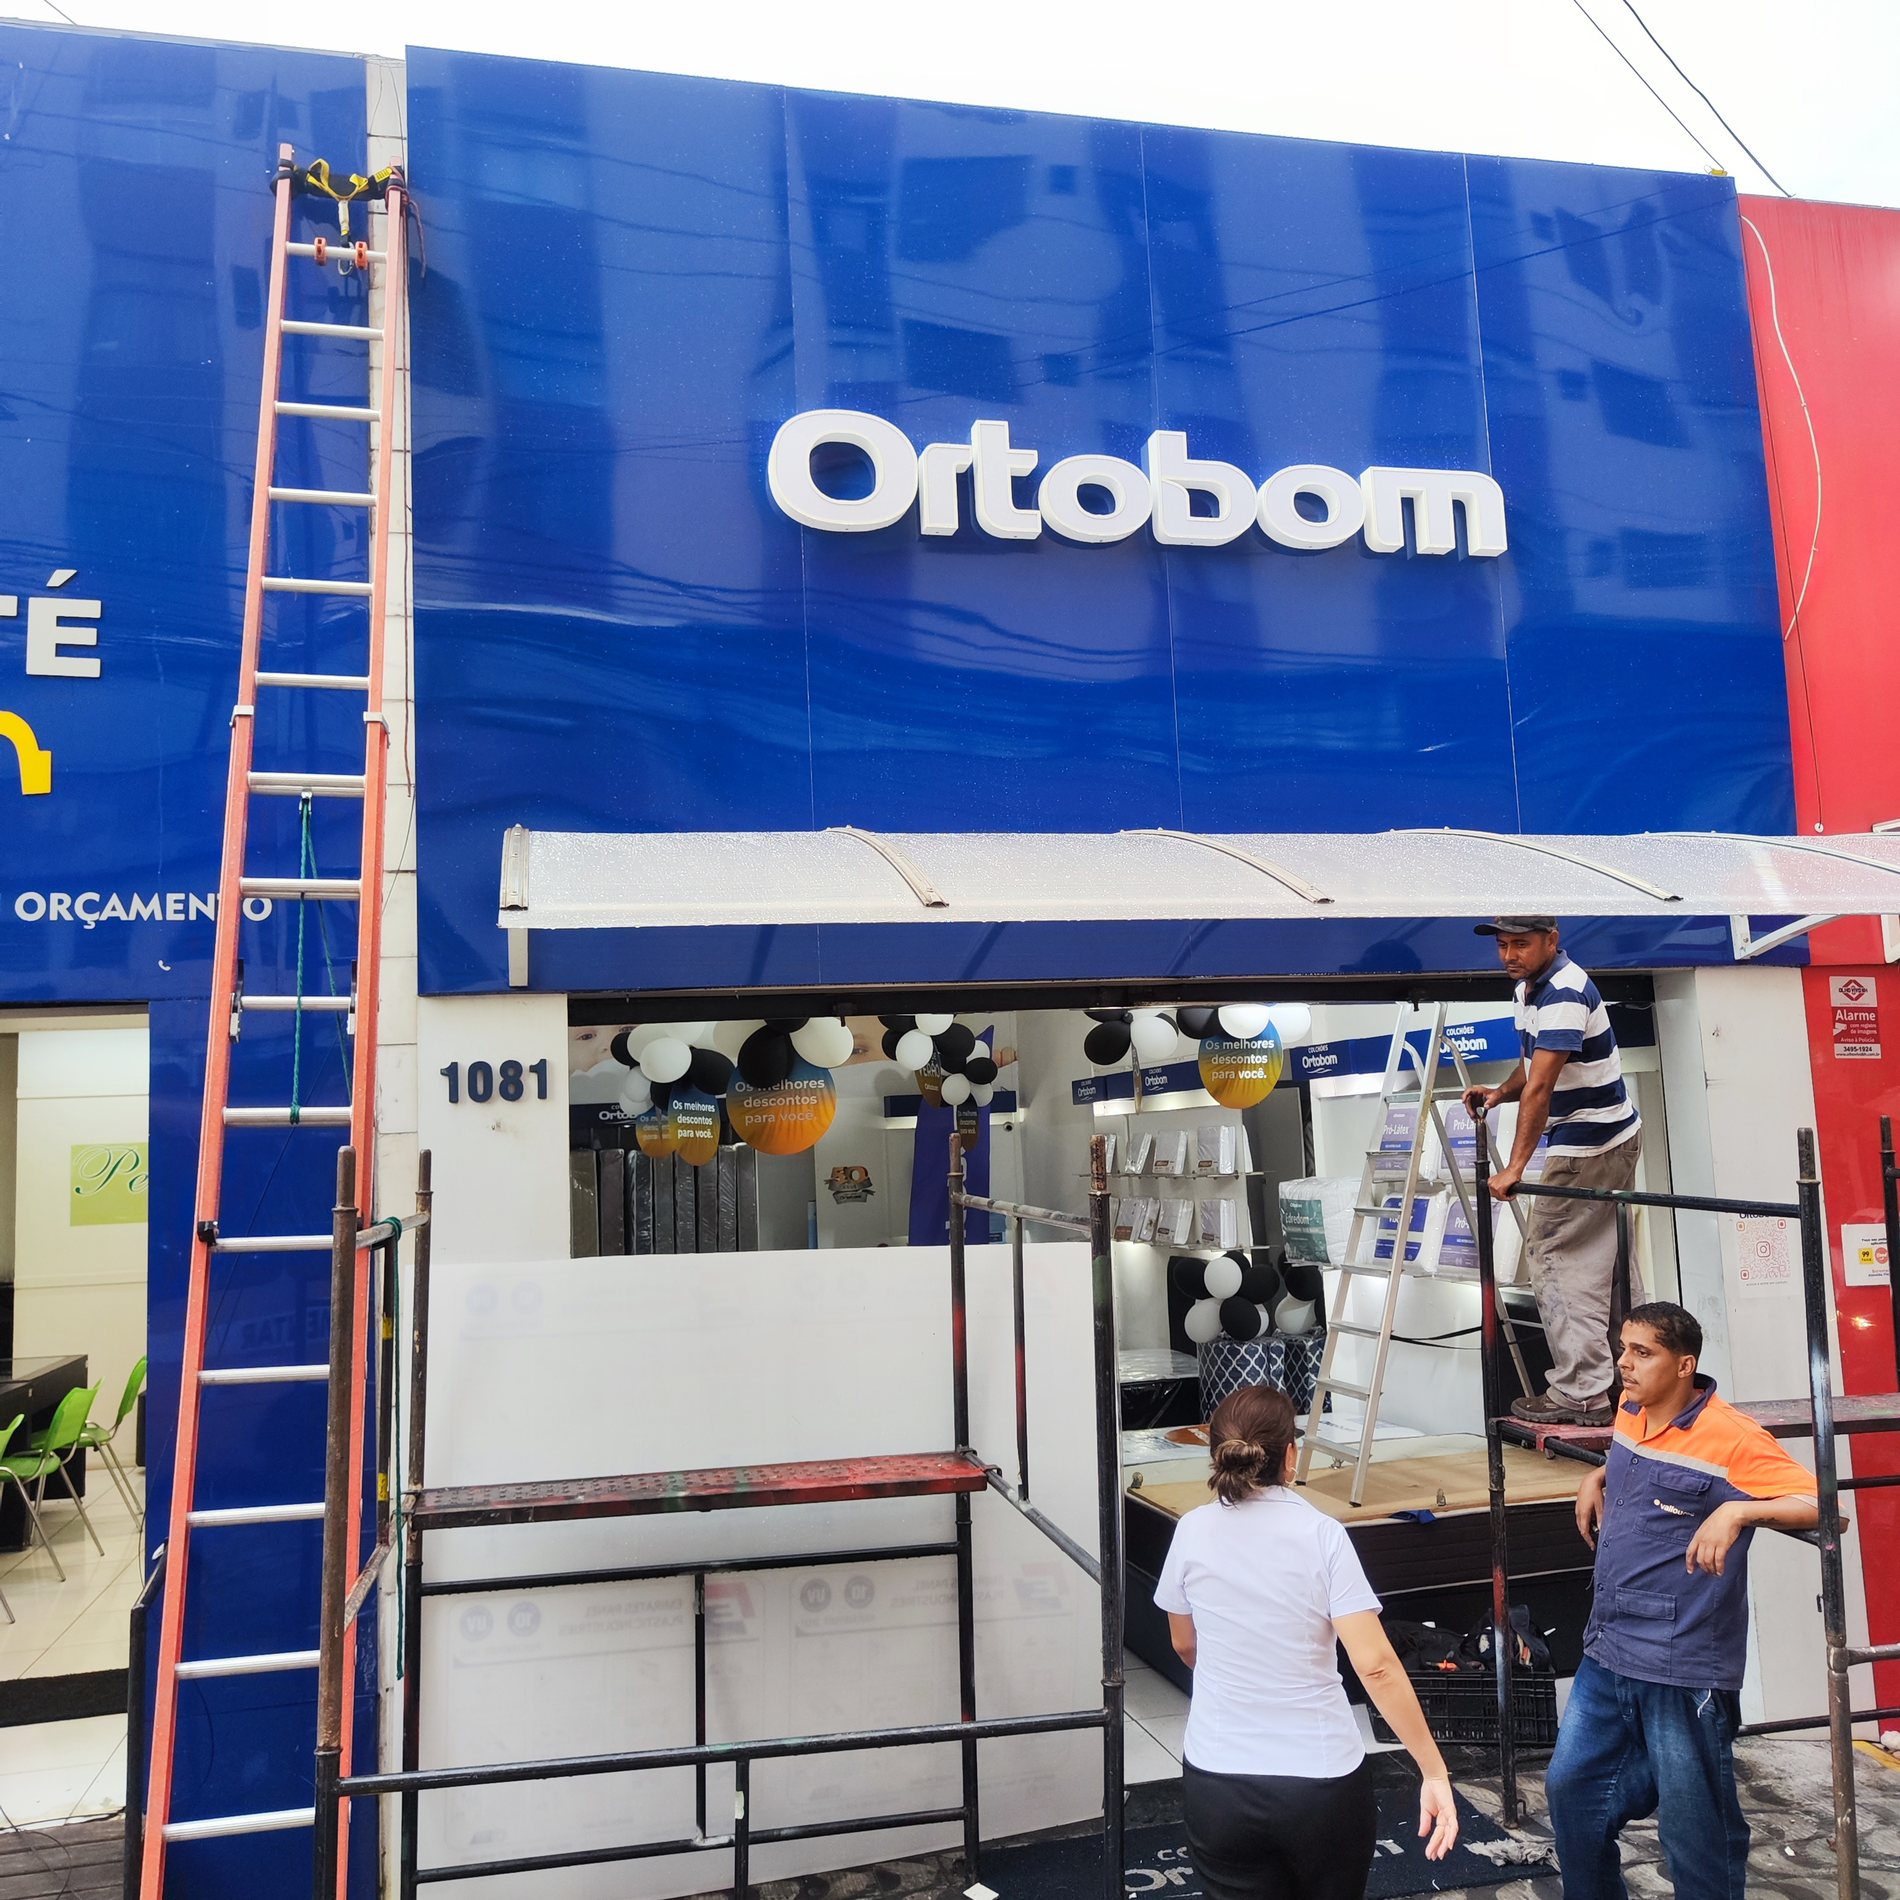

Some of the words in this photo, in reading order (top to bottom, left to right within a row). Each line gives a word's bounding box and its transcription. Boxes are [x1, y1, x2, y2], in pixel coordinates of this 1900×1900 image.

[768, 409, 1507, 557] Ortobom
[14, 891, 273, 929] ORÇAMENO
[1835, 1009, 1876, 1021] Alarme
[1205, 1040, 1220, 1050] Os
[1222, 1039, 1275, 1050] melhores
[1211, 1054, 1268, 1065] descontos
[1302, 1054, 1338, 1069] Ortobom
[1145, 1074, 1169, 1087] Ortobom
[1211, 1070, 1236, 1081] para
[1238, 1069, 1267, 1079] você.
[440, 1059, 548, 1104] 1081
[735, 1081, 754, 1092] Os
[757, 1079, 826, 1092] elhores
[1077, 1086, 1097, 1097] Ortobom
[672, 1100, 683, 1110] Os
[684, 1101, 716, 1112] melhores
[743, 1095, 818, 1108] descontos
[677, 1114, 713, 1126] descontos
[745, 1114, 776, 1126] para
[779, 1109, 817, 1121] você.
[677, 1129, 695, 1139] para
[1861, 1250, 1870, 1258] 99
